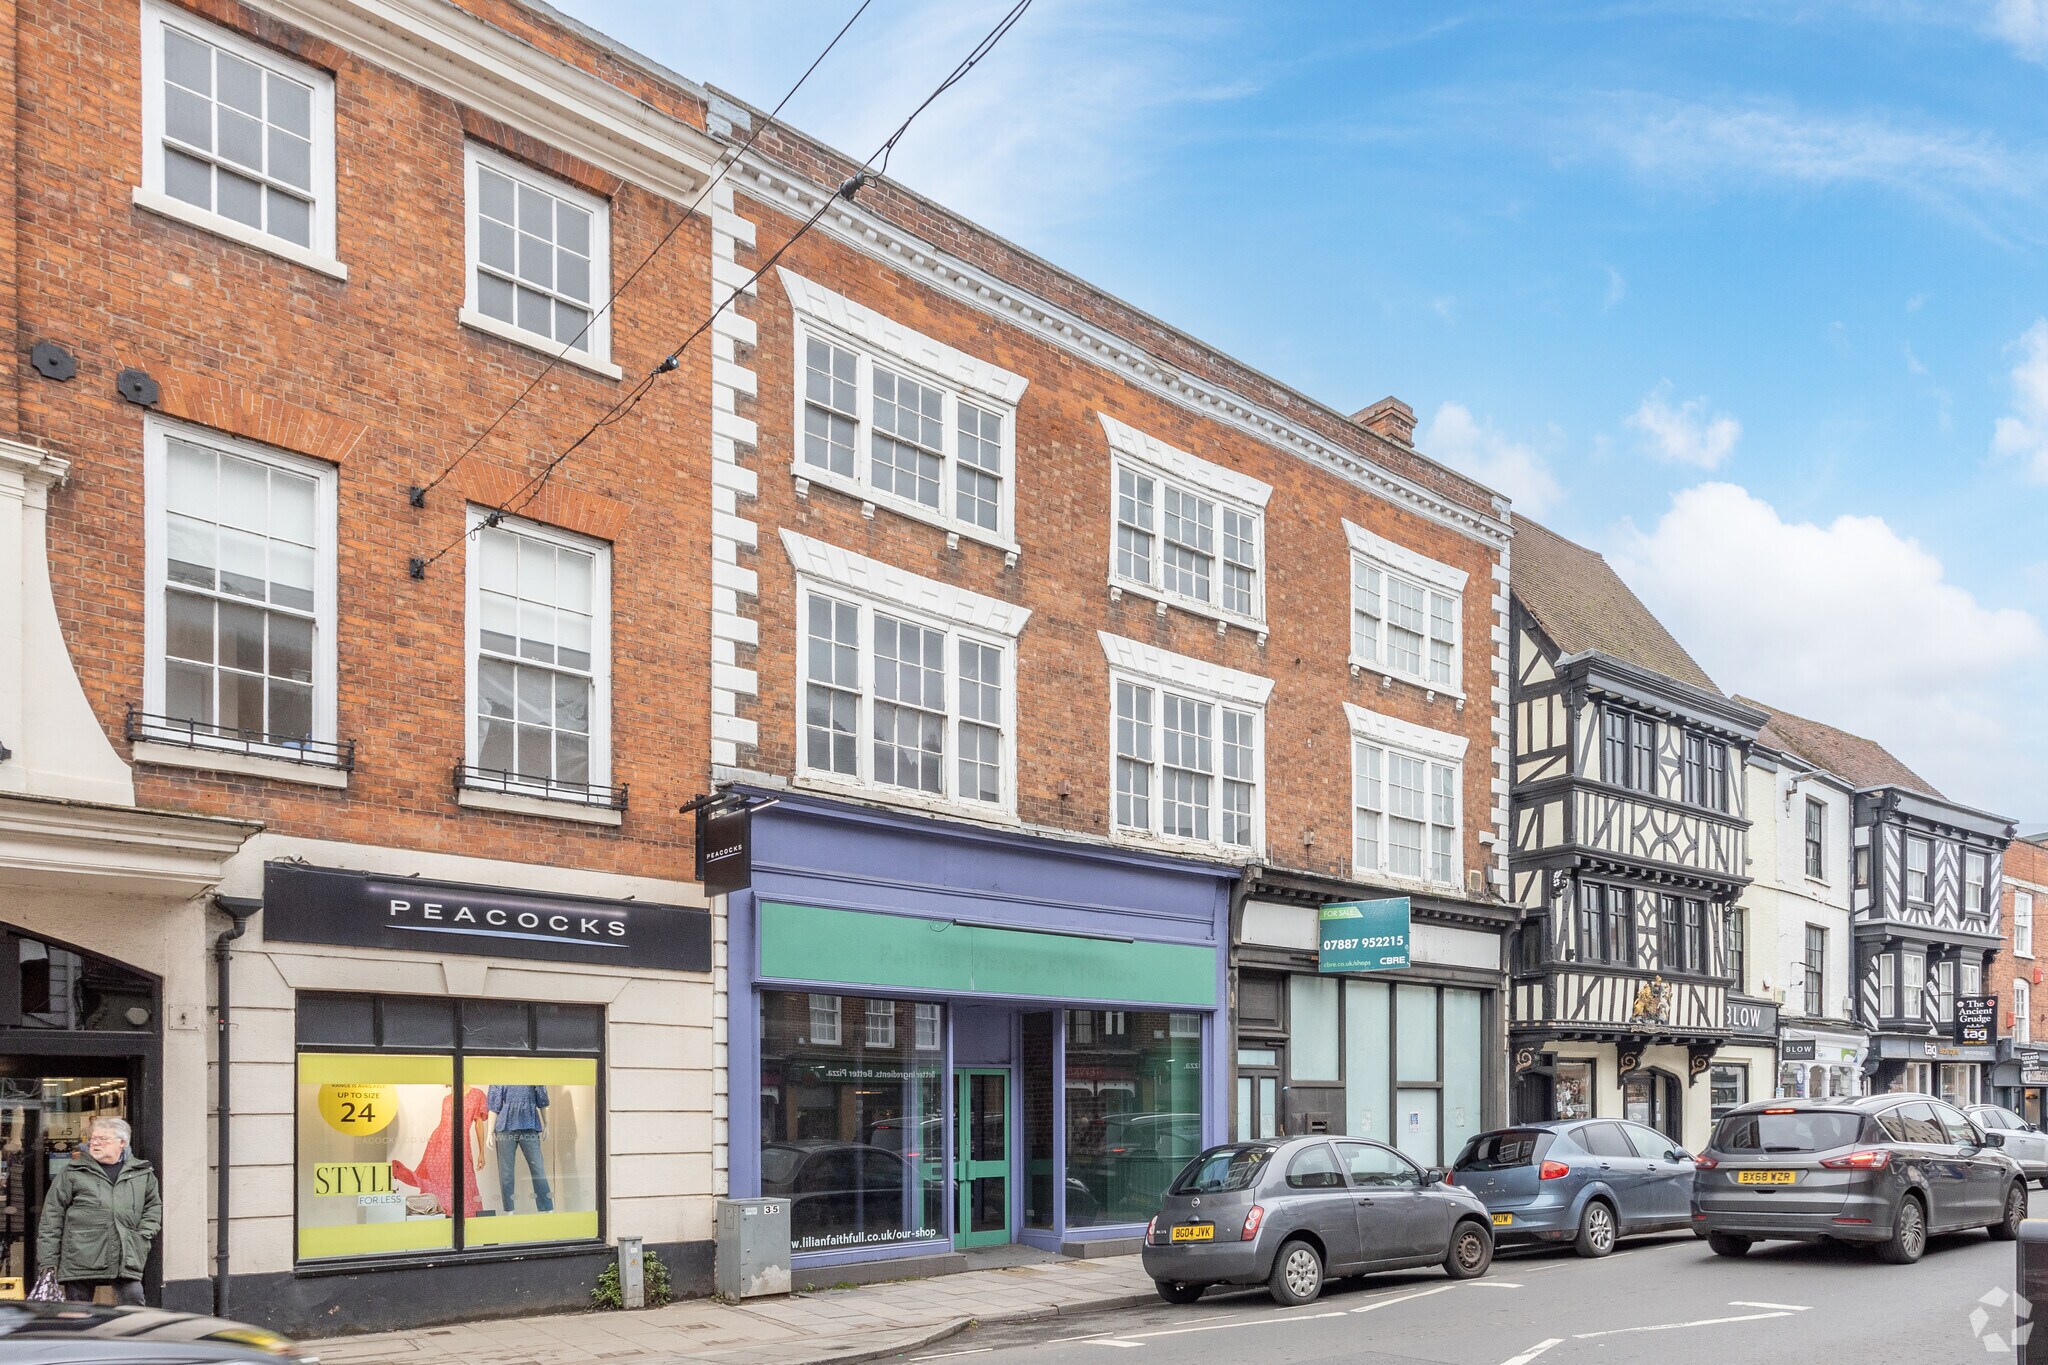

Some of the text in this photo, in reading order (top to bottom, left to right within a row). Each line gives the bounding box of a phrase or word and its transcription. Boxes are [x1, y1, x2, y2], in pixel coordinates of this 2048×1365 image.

[706, 844, 743, 860] PEACOCKS
[389, 899, 627, 937] PEACOCKS
[1323, 935, 1404, 951] 07887 952215
[1323, 960, 1371, 968] cbre.co.uk/shops
[1379, 955, 1406, 965] CBRE
[1966, 999, 1985, 1008] The
[1958, 1007, 1993, 1016] Ancient
[1959, 1014, 1992, 1024] Grudge
[1962, 1028, 1988, 1041] tag
[1785, 1045, 1813, 1053] BLOW
[1923, 1041, 1937, 1058] tag
[340, 1102, 376, 1123] 24
[60, 1127, 73, 1136] £5
[1742, 1172, 1791, 1181] BX68 WZR
[359, 1195, 402, 1205] FOR LESS
[765, 1205, 779, 1214] 35
[1175, 1228, 1194, 1238] BG04
[1195, 1226, 1211, 1237] JVK
